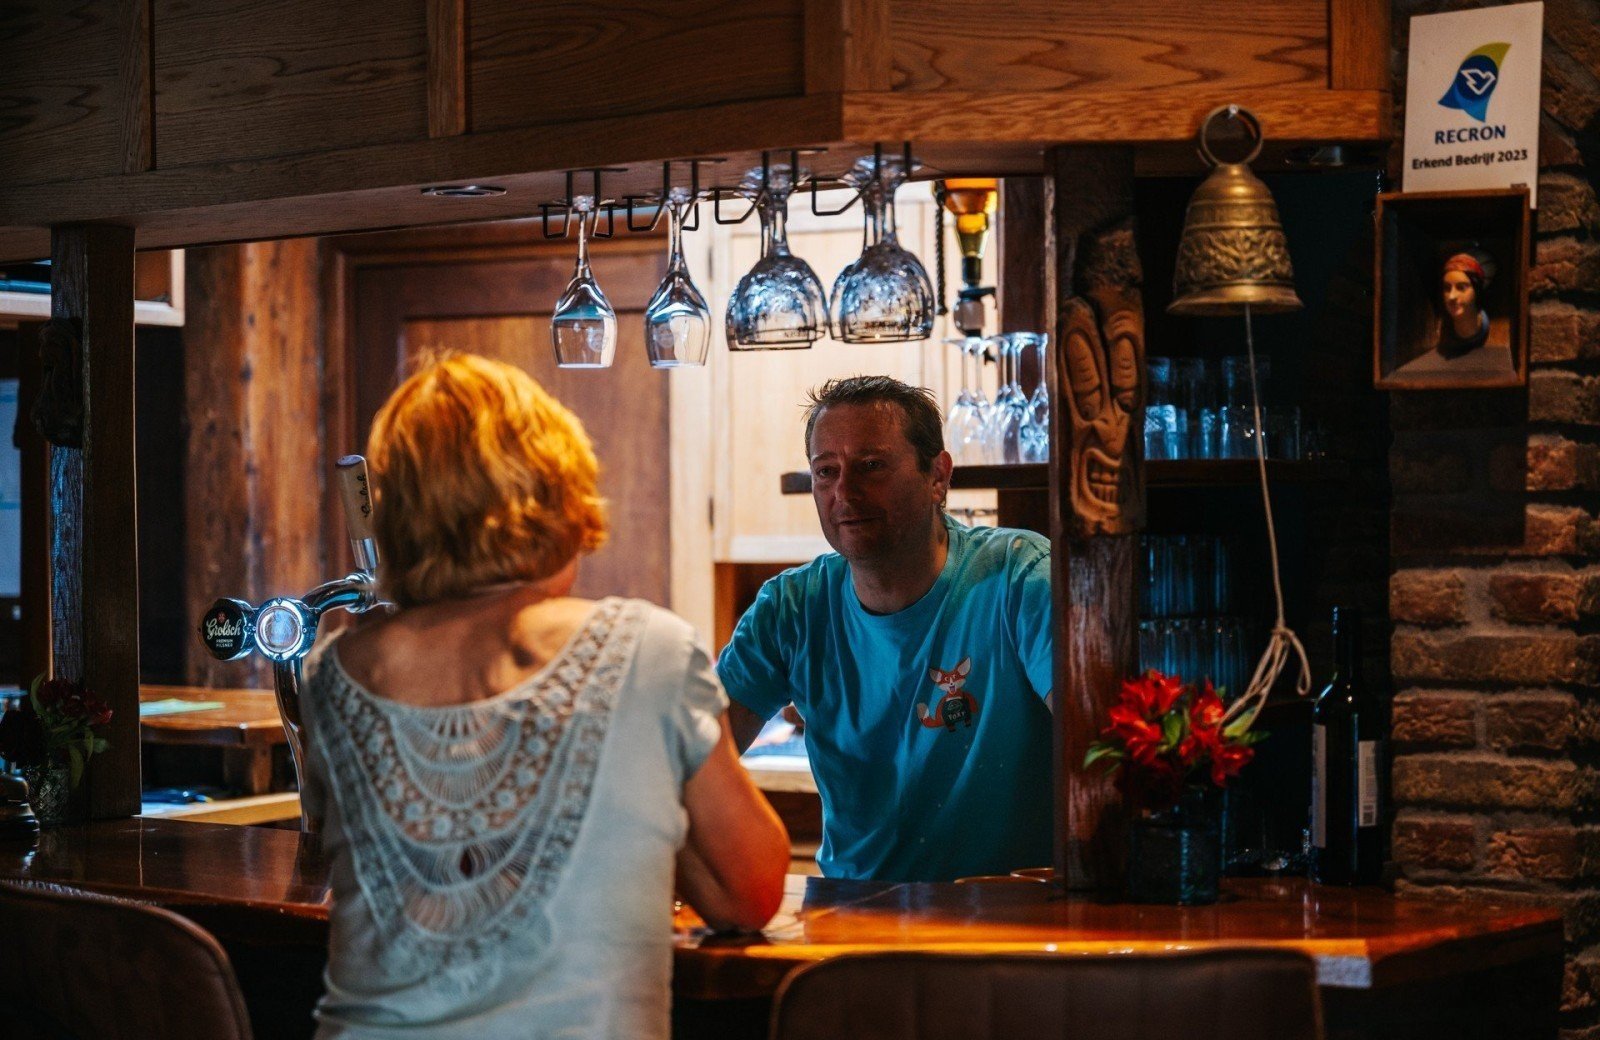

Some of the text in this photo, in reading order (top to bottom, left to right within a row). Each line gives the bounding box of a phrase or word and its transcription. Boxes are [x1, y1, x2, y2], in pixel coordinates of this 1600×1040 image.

[1434, 124, 1506, 145] RECRON
[1412, 149, 1528, 170] Erkend Bedrijf 2023
[206, 618, 242, 640] Grolsch
